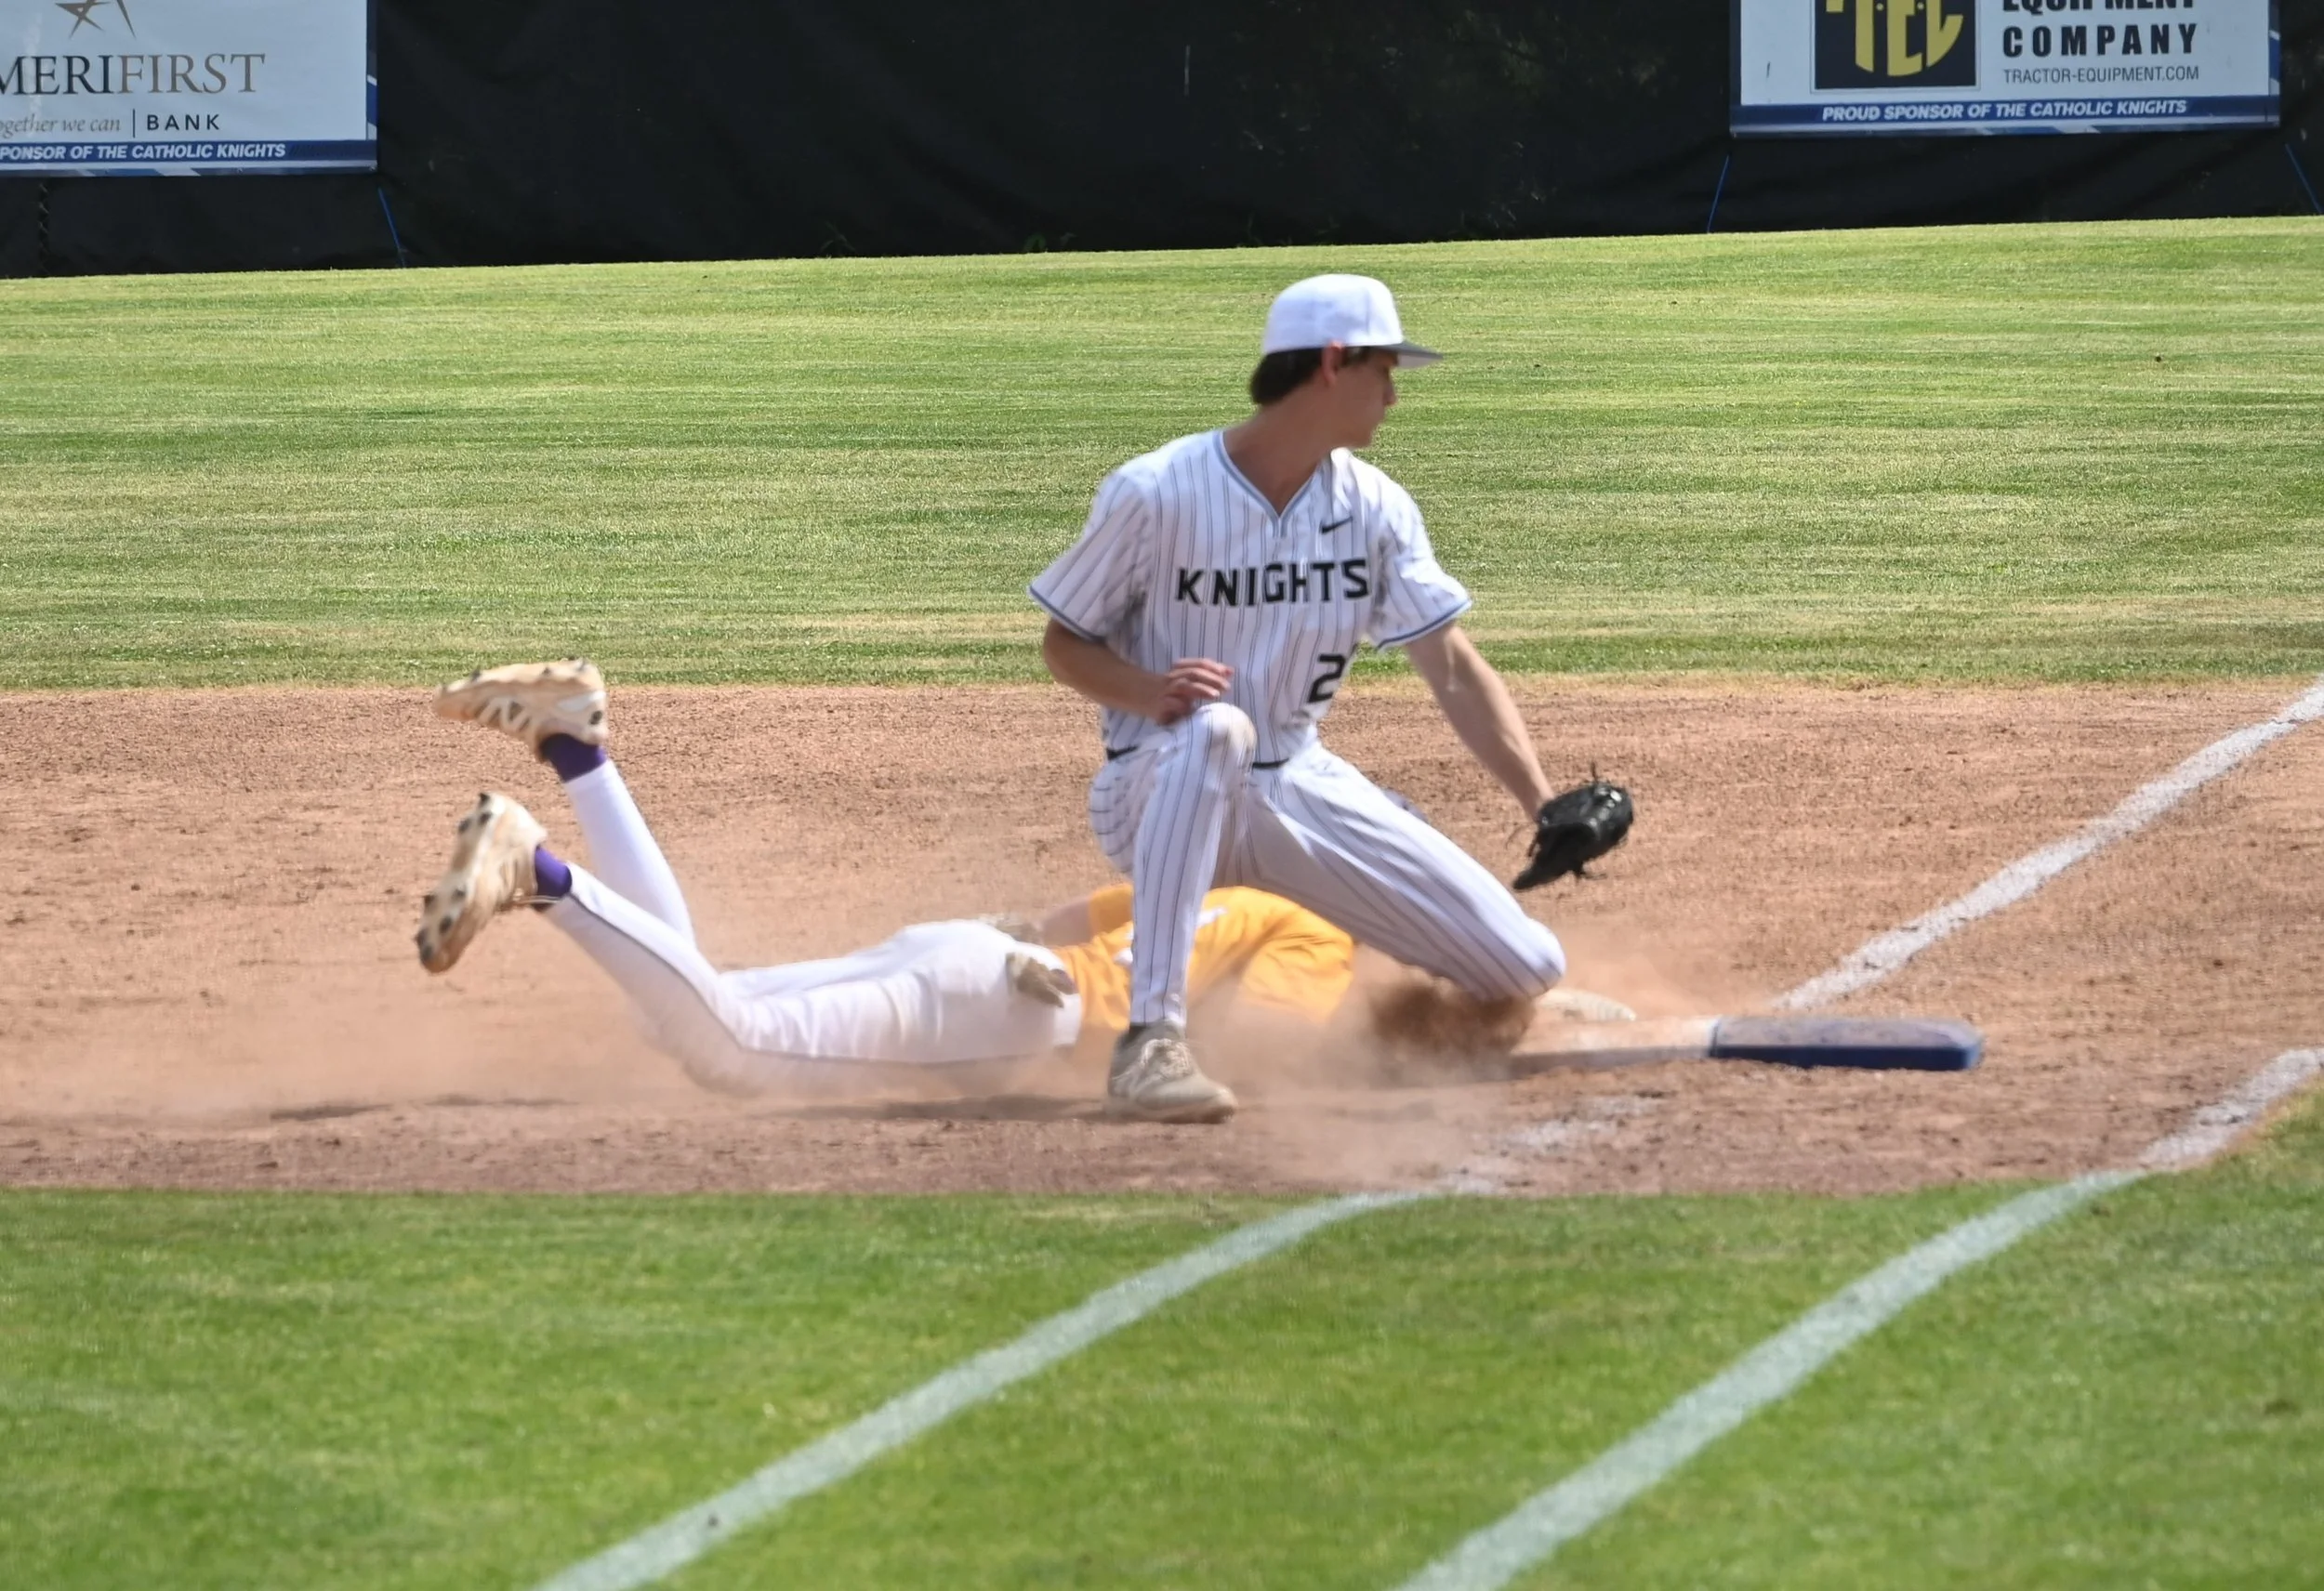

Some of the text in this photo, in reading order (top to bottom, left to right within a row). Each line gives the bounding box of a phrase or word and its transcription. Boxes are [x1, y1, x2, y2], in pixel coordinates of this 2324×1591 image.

[2002, 23, 2198, 58] COMPANY
[2003, 66, 2199, 84] TRACTOR-EQUIPMENT.COM
[1822, 99, 2187, 121] PROUD SPONSOR OF THE CATHOLIC KNIGHTS
[61, 118, 86, 132] we
[90, 118, 121, 132] can
[147, 113, 220, 131] BANK
[70, 145, 94, 160] OF
[97, 145, 128, 159] THE
[131, 144, 215, 159] CATHOLIC
[217, 143, 286, 158] KNIGHTS
[1176, 559, 1369, 607] KNIGHTS
[1306, 653, 1346, 703] 2
